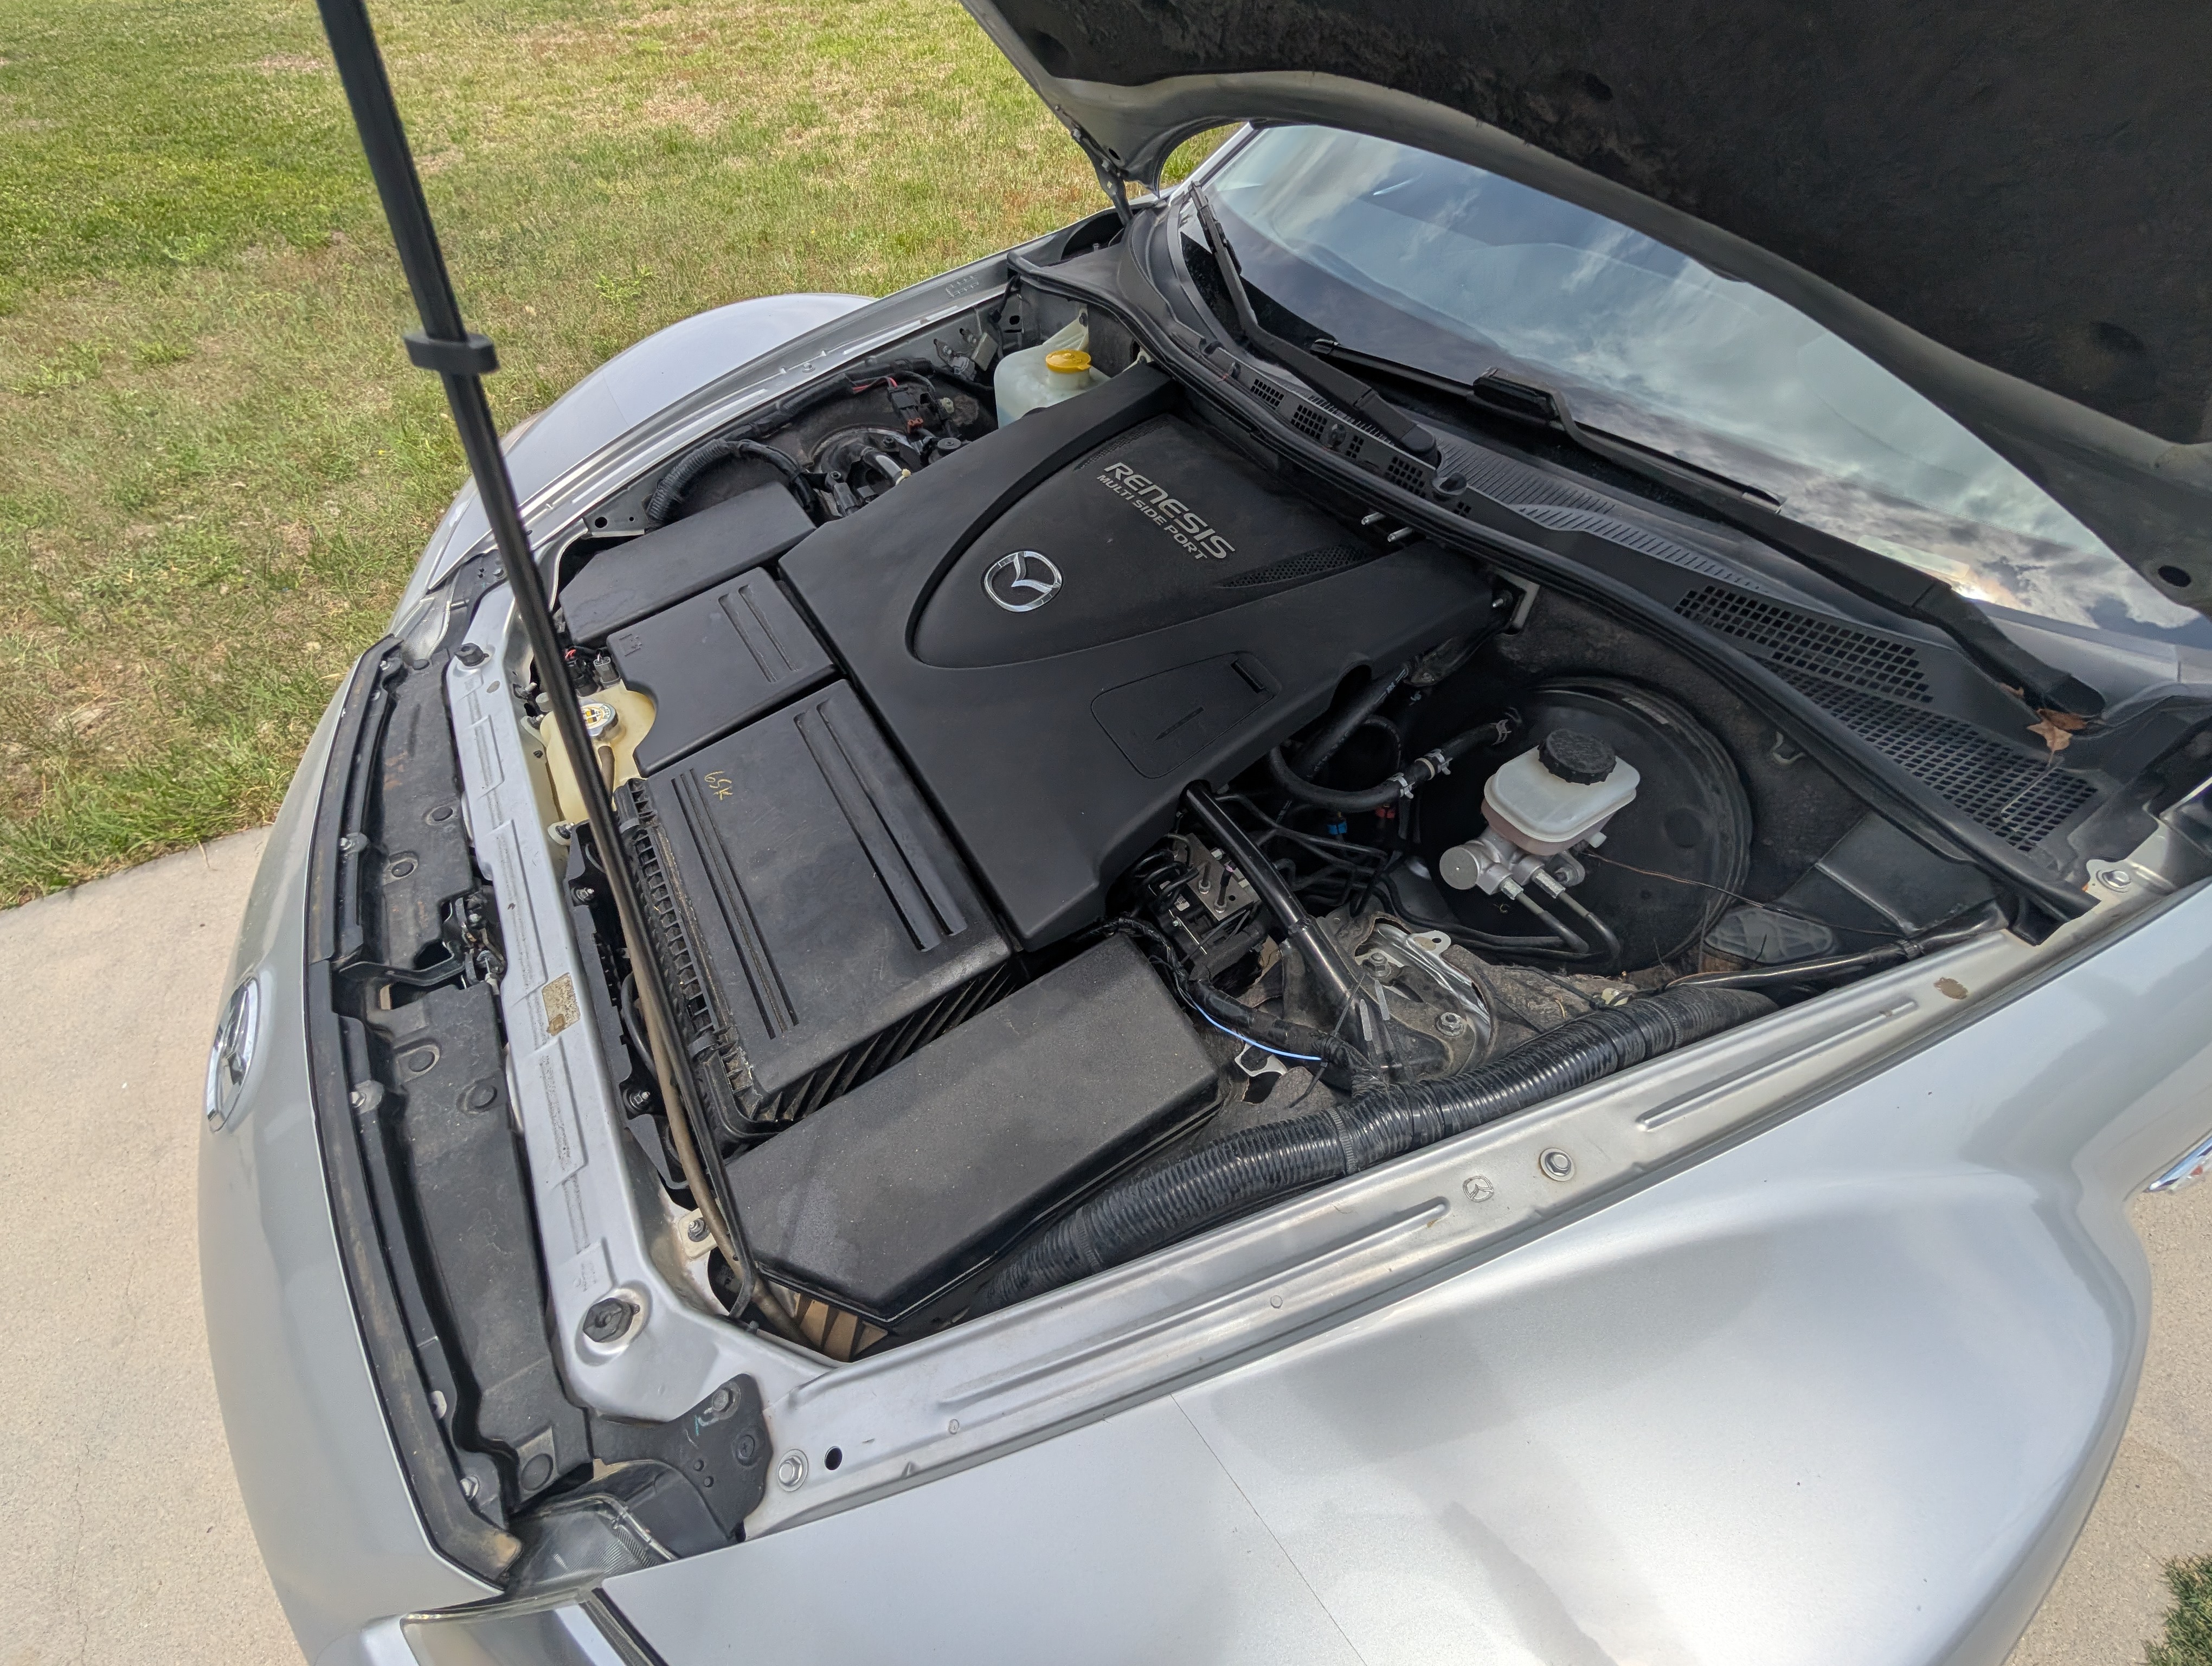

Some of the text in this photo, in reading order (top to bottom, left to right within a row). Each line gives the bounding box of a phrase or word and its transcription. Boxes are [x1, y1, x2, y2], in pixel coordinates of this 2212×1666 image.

[1096, 475, 1208, 560] MULTI SIDE PORT
[1103, 462, 1236, 559] RENESIS
